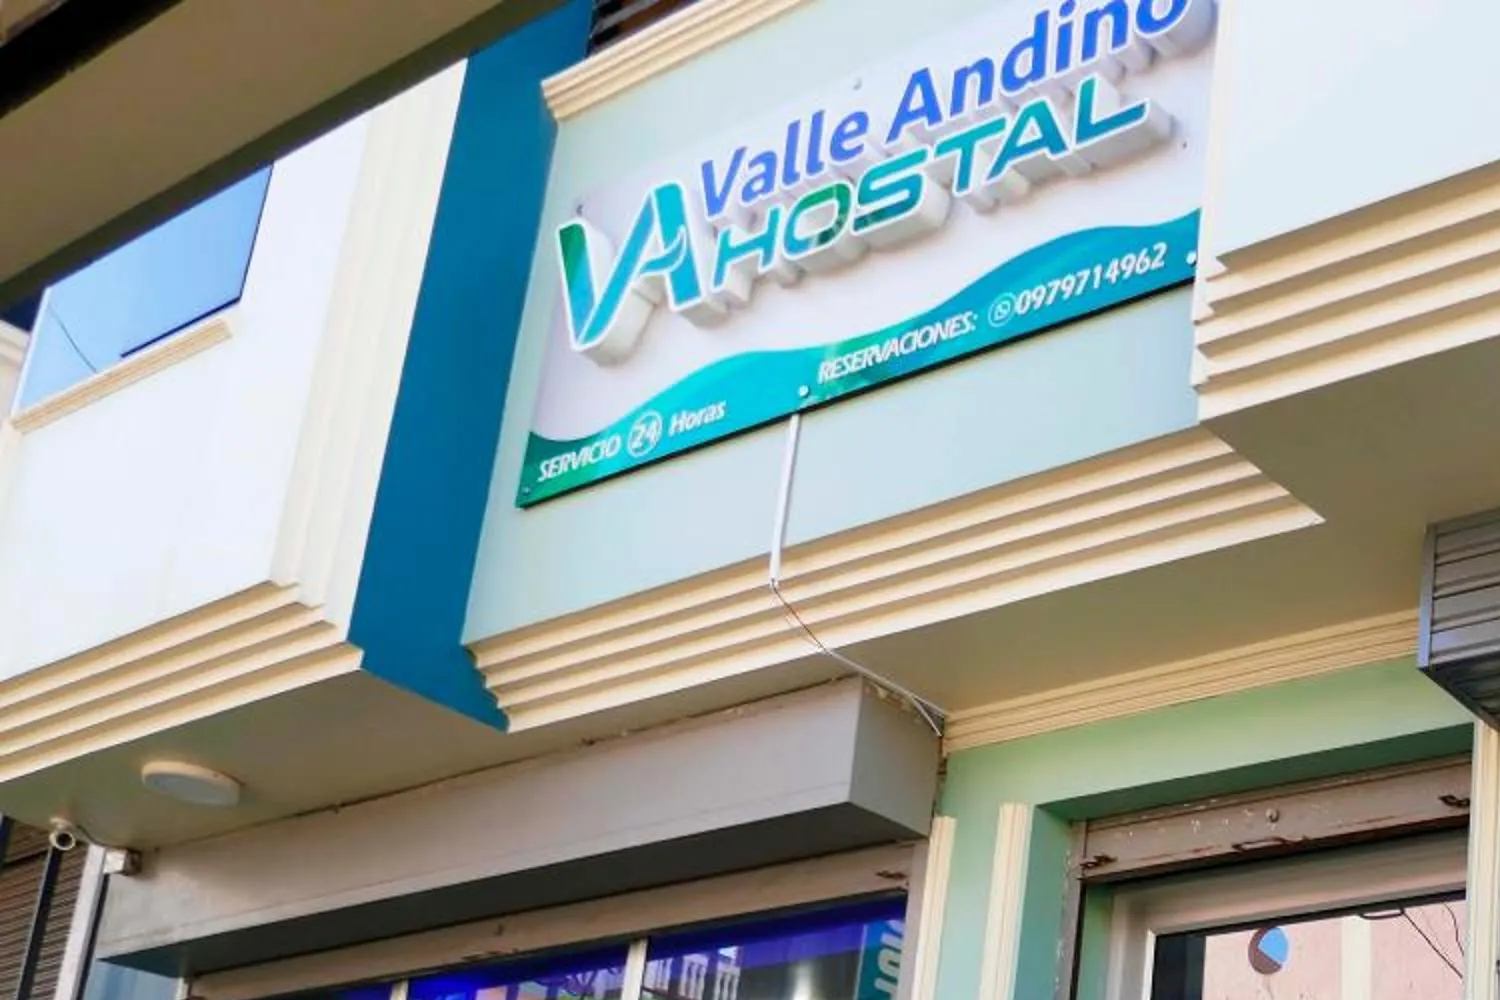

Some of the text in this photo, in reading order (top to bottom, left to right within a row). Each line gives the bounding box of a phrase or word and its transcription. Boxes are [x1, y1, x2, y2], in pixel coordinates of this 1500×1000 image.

[700, 0, 1188, 216] Valle Andino
[714, 79, 1148, 287] HOSTAL
[818, 242, 1168, 384] RESERVACIONES: 0979714962
[538, 401, 726, 481] SERVICIO 24 Horas
